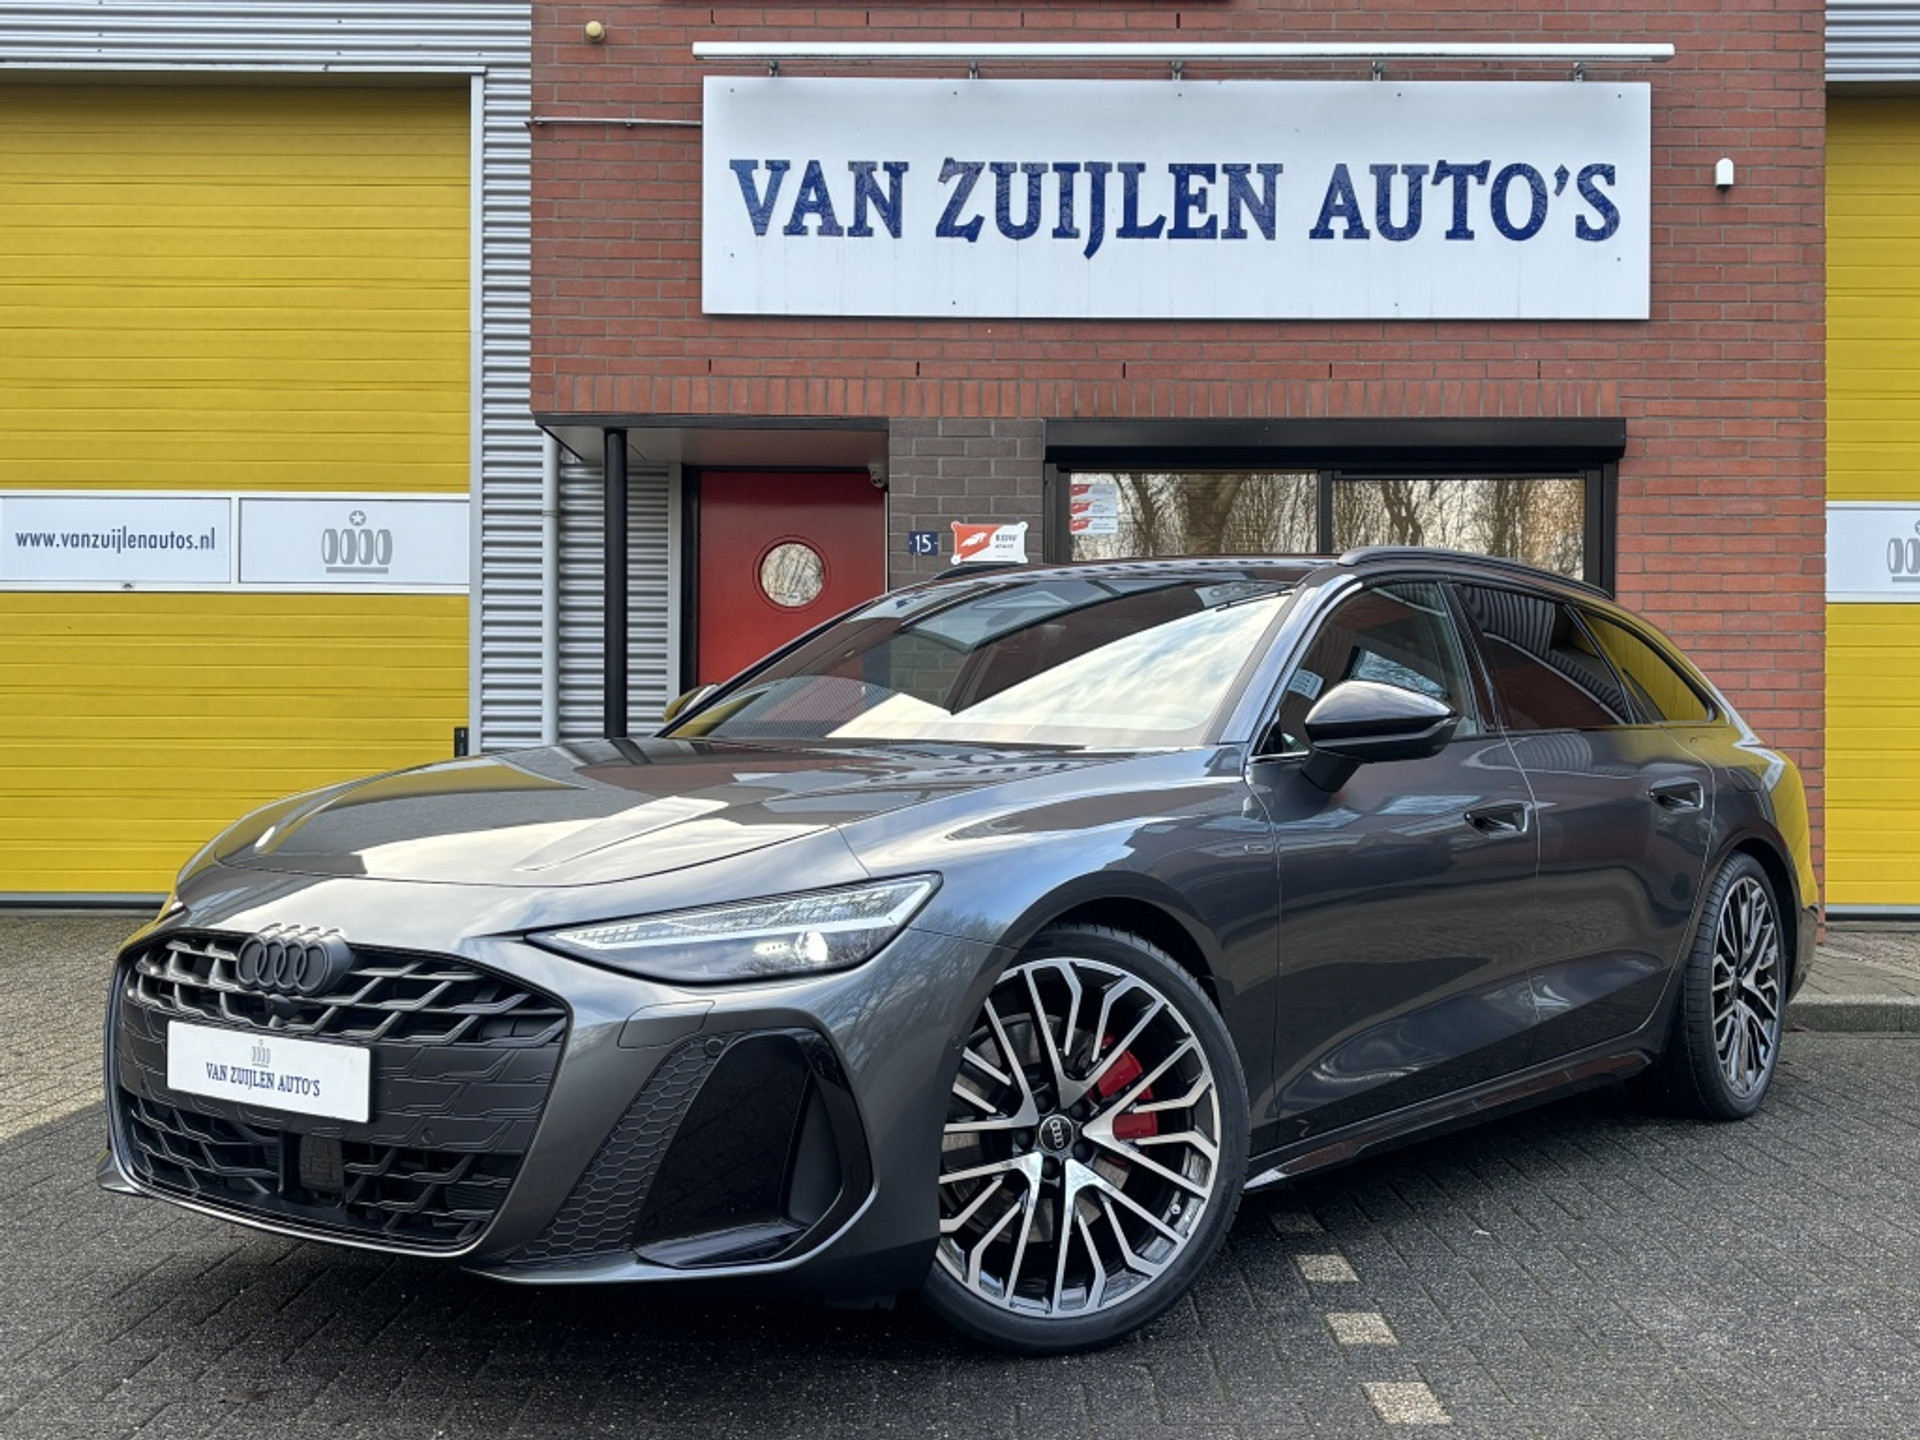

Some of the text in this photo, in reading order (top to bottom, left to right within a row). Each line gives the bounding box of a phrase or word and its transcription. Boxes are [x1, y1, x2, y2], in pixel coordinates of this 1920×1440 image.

[730, 158, 1621, 260] VAN ZUIJLEN AUTO'S
[15, 526, 216, 554] www.vanzuijlenautos.nl
[914, 534, 932, 553] 15
[206, 1062, 321, 1097] VAN ZUIJLEN AUTO'S
